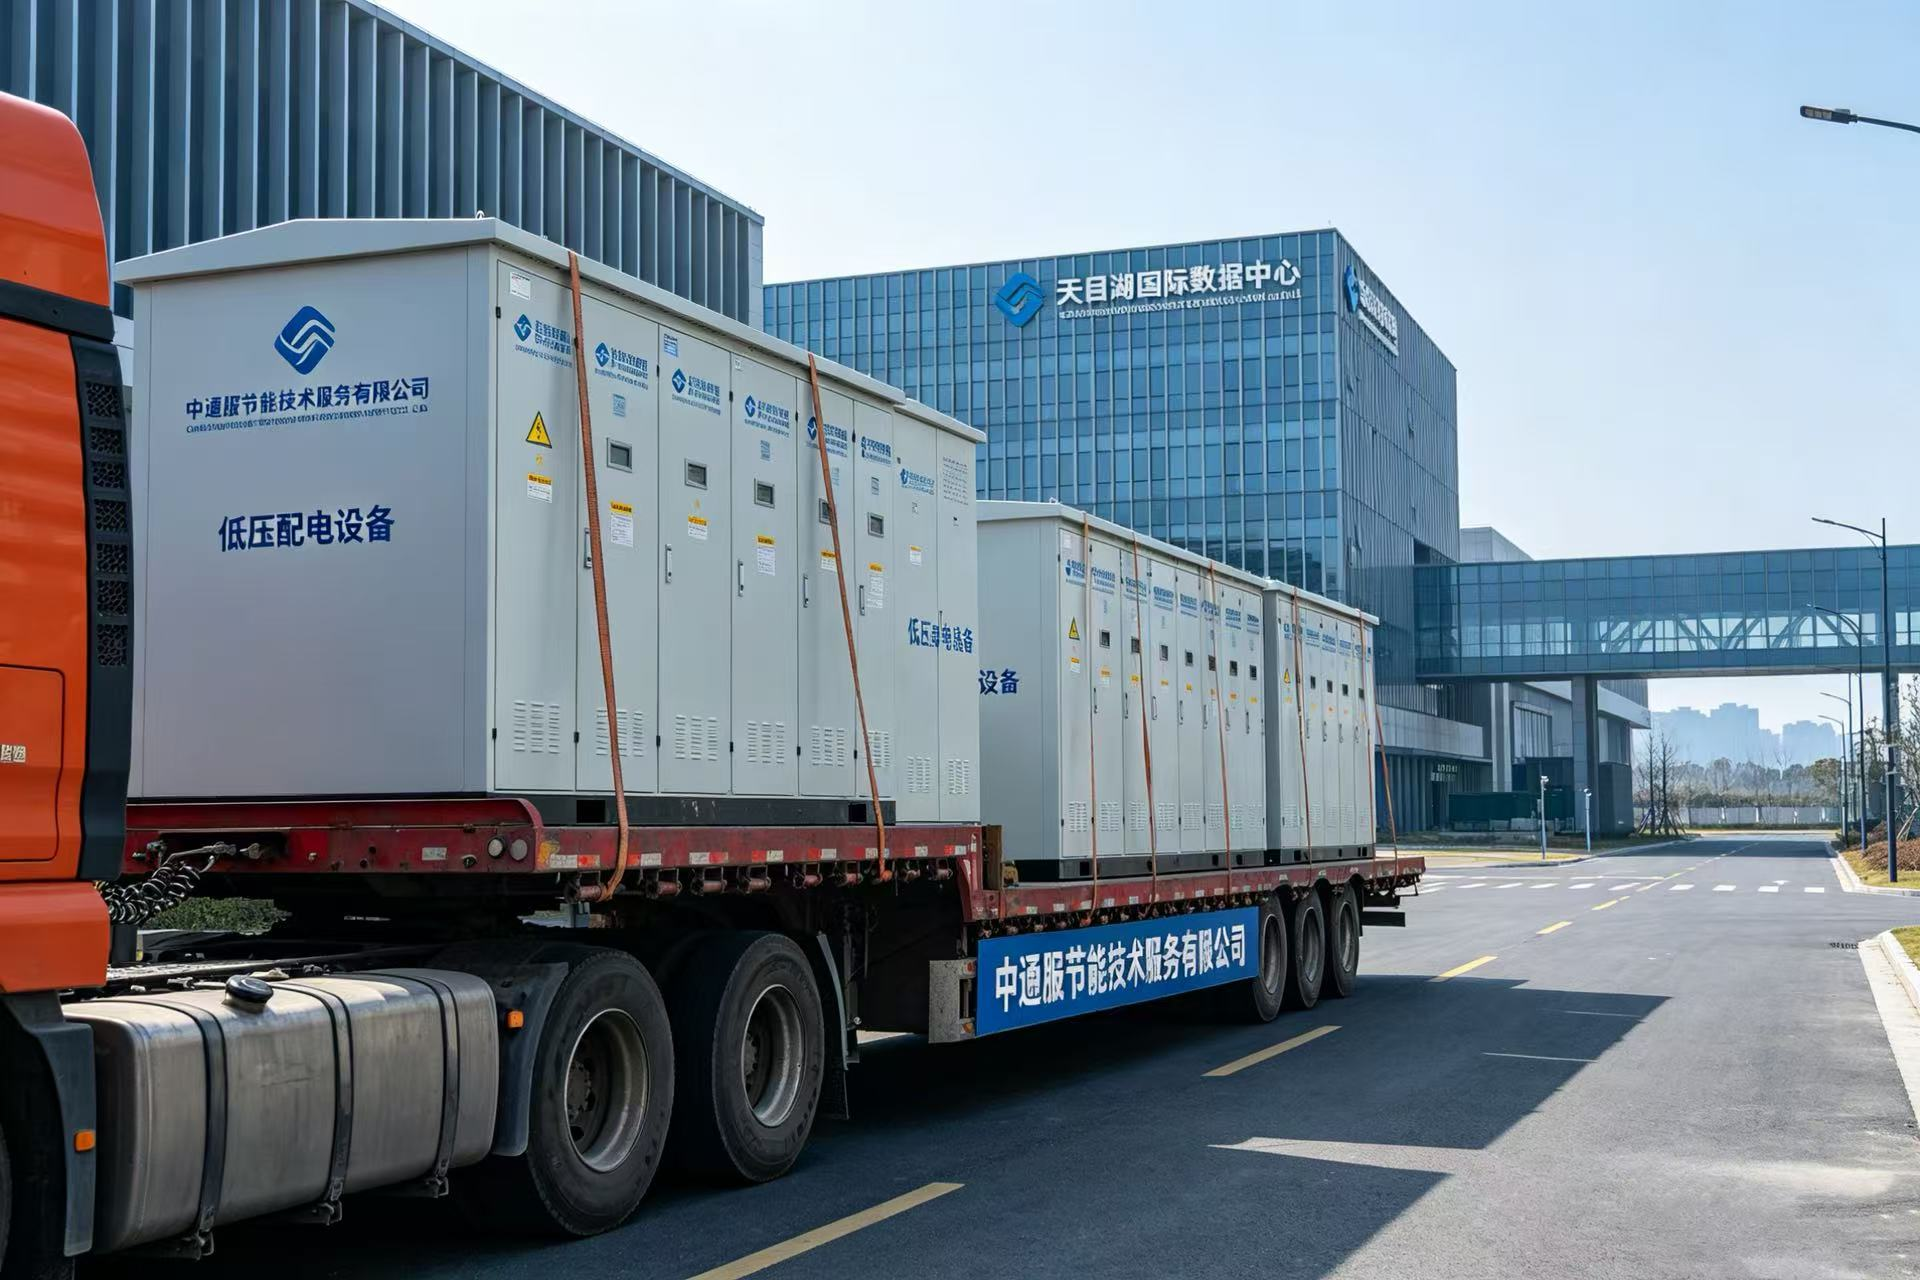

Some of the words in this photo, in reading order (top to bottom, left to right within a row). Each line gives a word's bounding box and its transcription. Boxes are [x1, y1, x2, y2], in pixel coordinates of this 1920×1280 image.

[1056, 258, 1301, 305] 天目湖国际数据中心
[218, 504, 396, 552] 低压配电设备
[995, 923, 1246, 1013] 中通服节能技术服务有限公司
